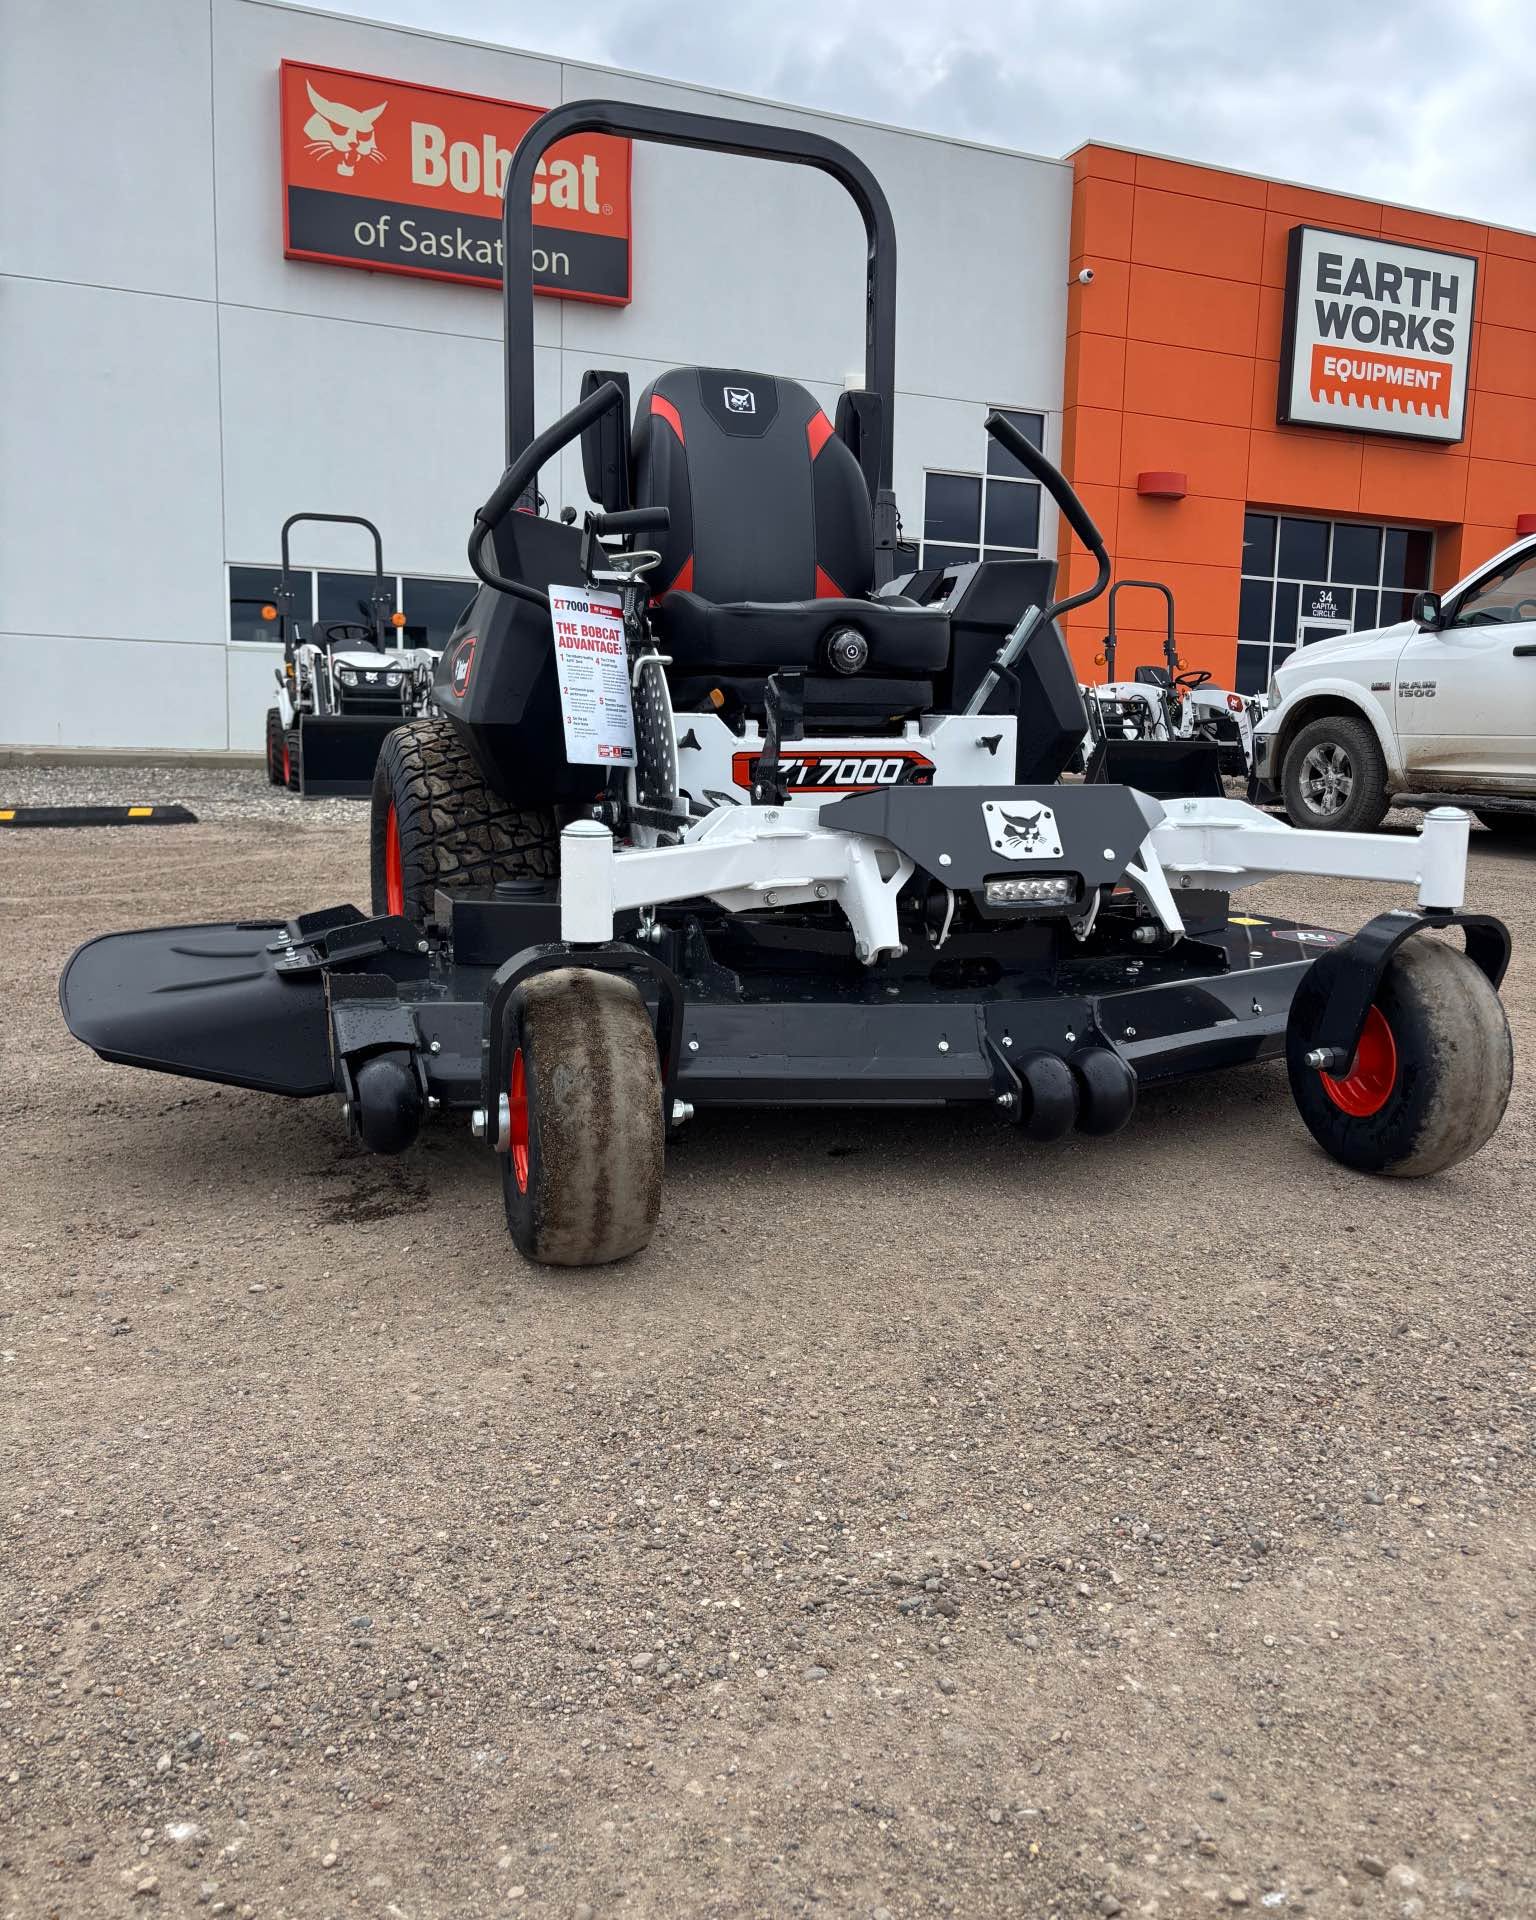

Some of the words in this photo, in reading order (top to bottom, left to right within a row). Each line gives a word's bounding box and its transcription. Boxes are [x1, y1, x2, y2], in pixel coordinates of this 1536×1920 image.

[354, 215, 391, 248] of
[400, 220, 570, 276] Saskaton
[1316, 251, 1459, 314] EARTH
[1314, 299, 1455, 356] WORKS
[1323, 356, 1441, 390] EQUIPMENT
[1319, 590, 1333, 603] 34
[553, 599, 589, 613] ZT7000
[1311, 602, 1338, 611] CAPITAL
[1312, 609, 1336, 618] CIRCLE
[556, 621, 578, 636] THE
[581, 625, 621, 642] BOBCAT
[558, 636, 623, 656] ADVANTAGE:
[1399, 681, 1436, 689] RAM
[1399, 689, 1436, 698] 1500
